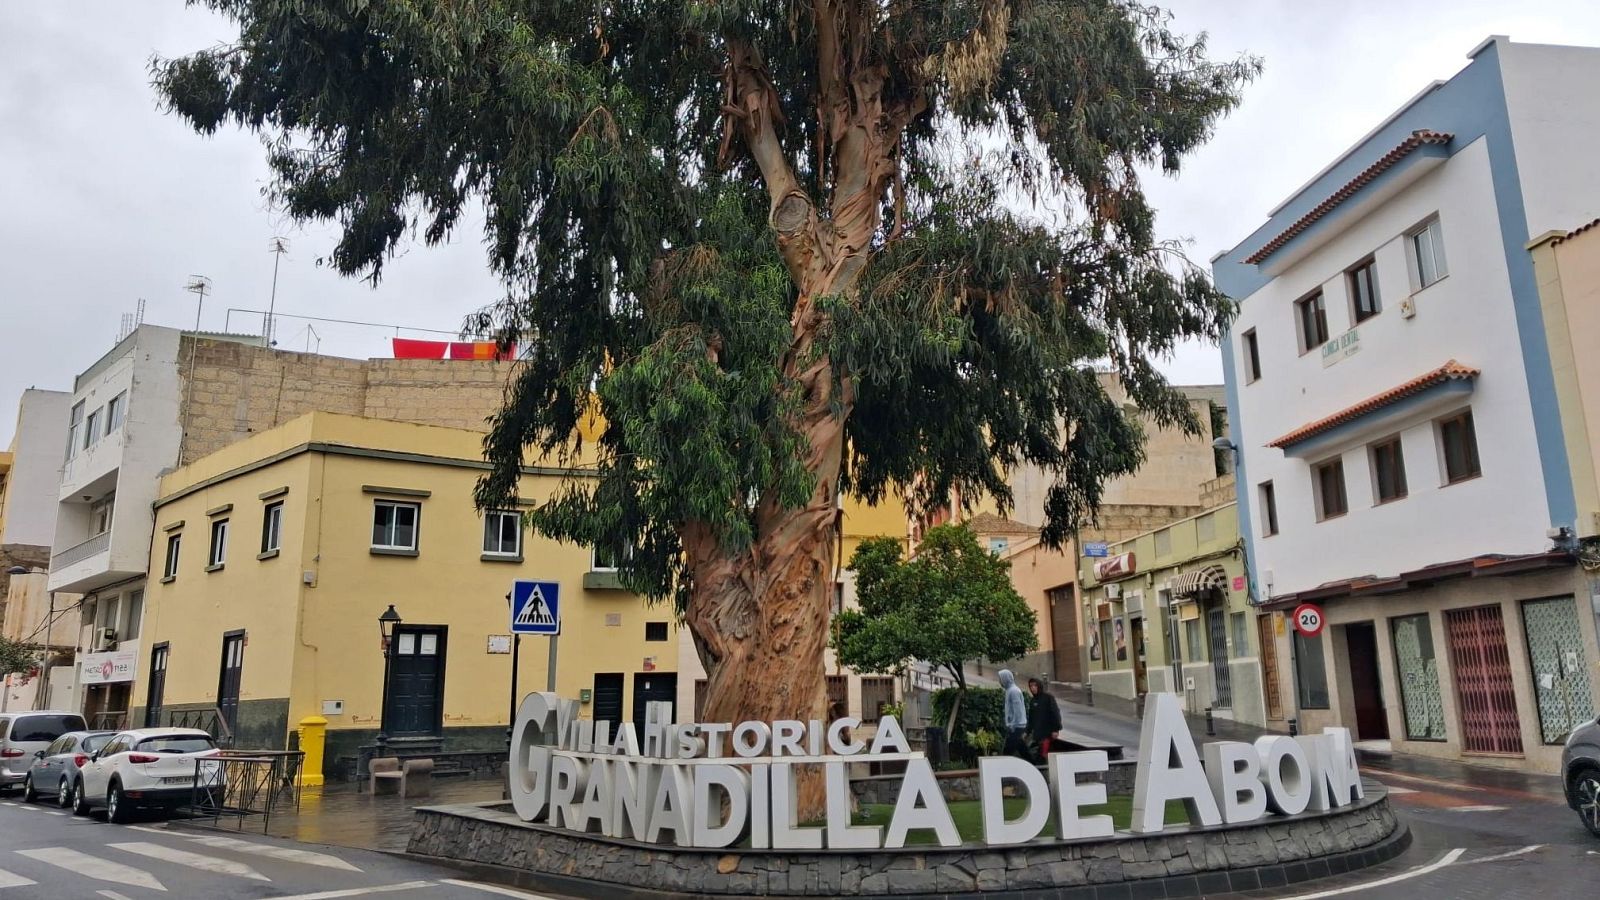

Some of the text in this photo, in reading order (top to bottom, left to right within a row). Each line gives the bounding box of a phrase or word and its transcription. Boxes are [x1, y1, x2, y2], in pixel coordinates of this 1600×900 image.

[1301, 614, 1318, 625] 20
[556, 698, 912, 760] VILLA HISTORICA
[509, 691, 1364, 850] GRANADILLA DE ABONA
